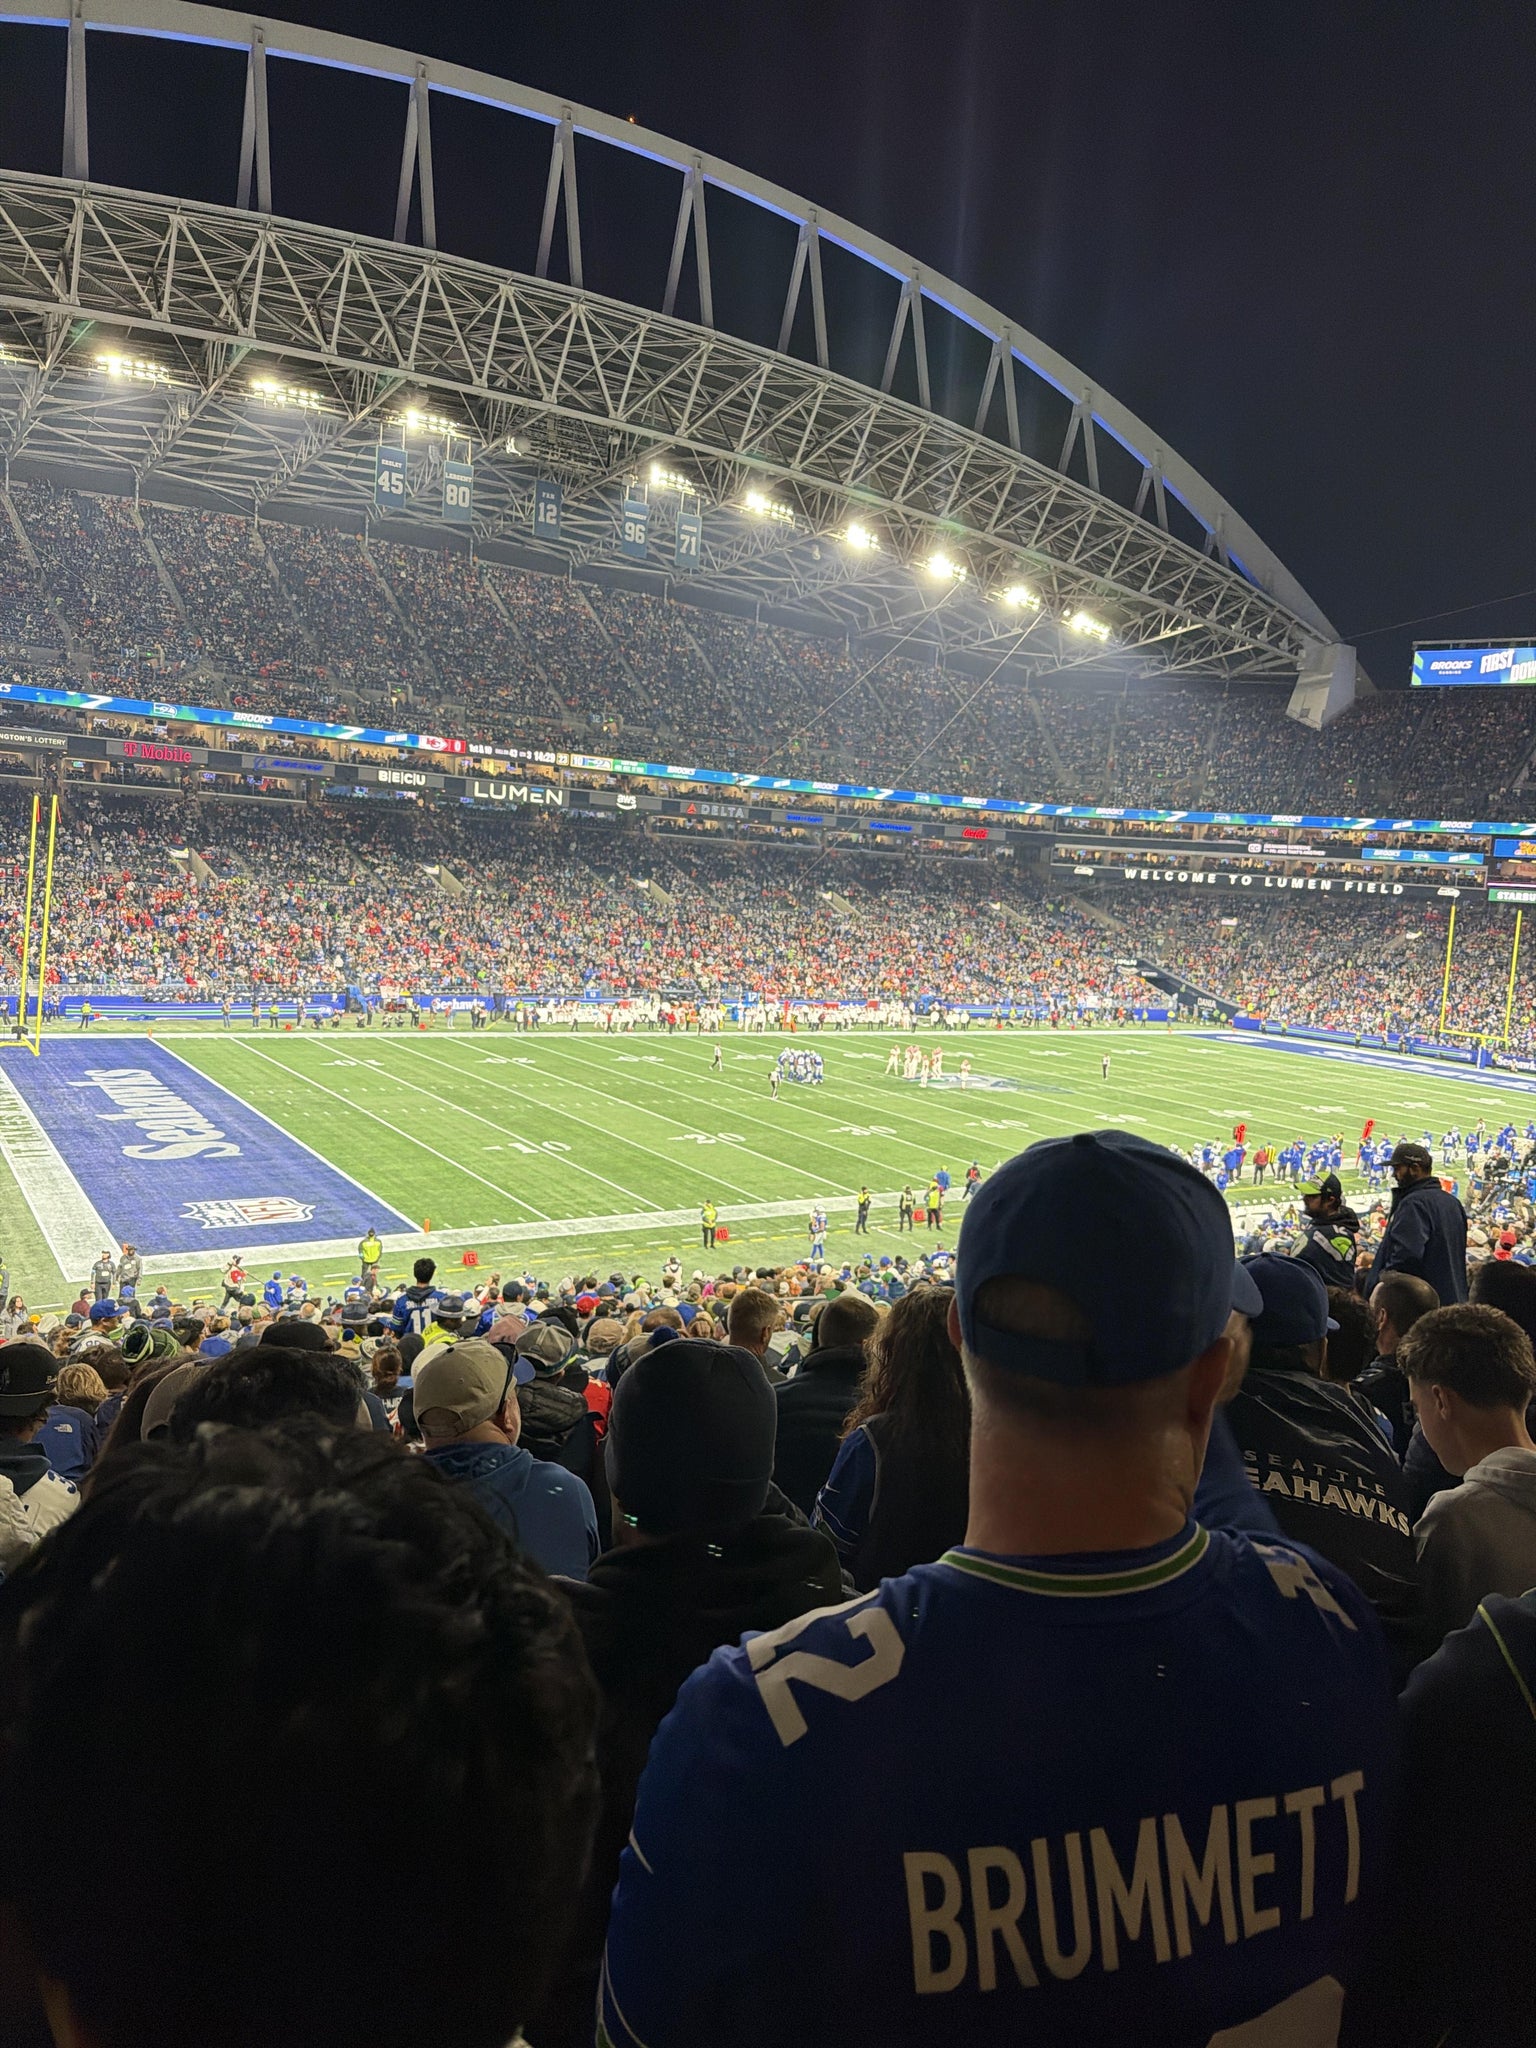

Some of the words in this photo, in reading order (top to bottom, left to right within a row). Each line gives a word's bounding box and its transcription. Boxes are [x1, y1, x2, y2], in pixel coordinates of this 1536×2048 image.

[377, 471, 404, 495] 45
[446, 484, 470, 508] 80
[538, 501, 557, 525] 12
[624, 522, 646, 544] 96
[679, 534, 697, 556] 71
[1430, 660, 1473, 671] BROOKS
[1480, 648, 1515, 674] FIRST
[233, 712, 274, 725] BROOKS
[35, 737, 66, 746] LOTTERY
[123, 742, 137, 757] T
[140, 743, 192, 763] Mobile
[453, 741, 461, 752] 0
[473, 781, 563, 806] LUMEN
[617, 793, 637, 804] aws
[701, 804, 744, 819] DELTA
[1124, 868, 1217, 884] WELCOME
[1228, 873, 1253, 886] TO
[1264, 876, 1332, 891] LUMEN
[1344, 881, 1404, 895] FIELD
[66, 1068, 244, 1160] Seahawks
[467, 1253, 476, 1264] G
[410, 1308, 432, 1334] 11
[1243, 1450, 1386, 1497] SEATTLE
[903, 1769, 1365, 1994] BRUMMETT
